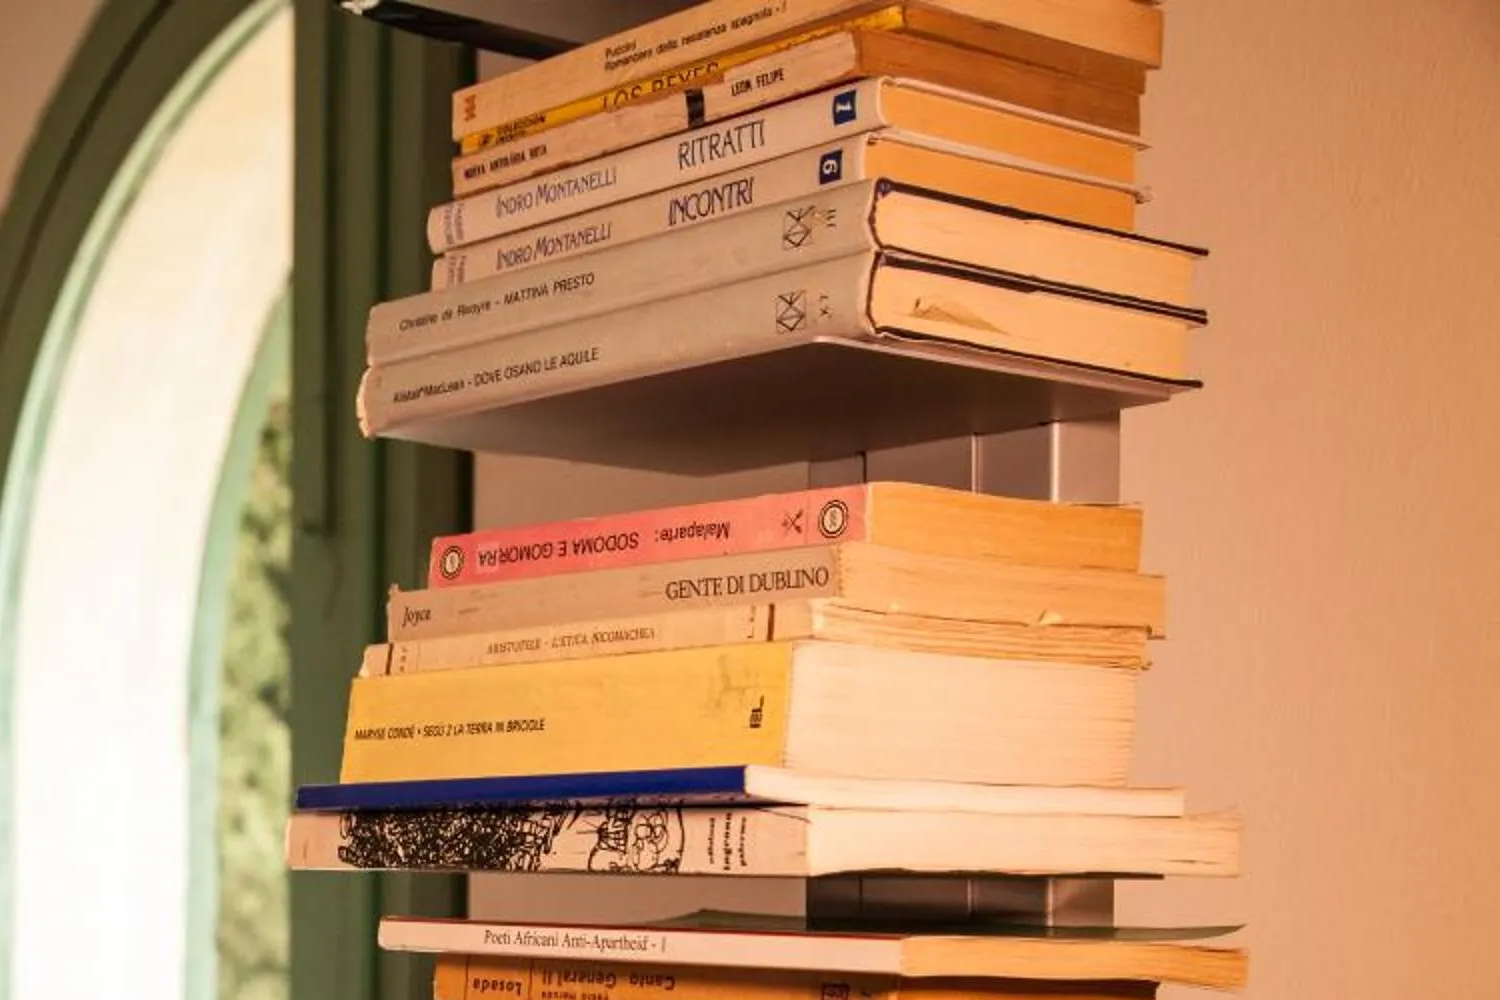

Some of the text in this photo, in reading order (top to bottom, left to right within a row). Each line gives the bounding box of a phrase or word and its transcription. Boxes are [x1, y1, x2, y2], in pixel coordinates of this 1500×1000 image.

[756, 67, 785, 89] FELIPE
[678, 119, 765, 170] RITRATTI
[495, 167, 617, 218] INDRO MONTANELLI
[667, 176, 755, 227] INCONTRI
[496, 245, 533, 271] INDRO
[533, 221, 613, 261] MONTANELLI
[503, 286, 550, 306] MATTINA
[553, 271, 596, 296] PRESTO
[473, 370, 502, 389] DOVE
[543, 356, 559, 372] LE
[559, 347, 600, 369] AQUILE
[478, 532, 640, 567] SODOMA E GOMORRA
[665, 566, 830, 601] GENTE DI DUBLINO
[401, 607, 432, 628] Joyce
[483, 929, 511, 945] Poeti
[515, 930, 558, 948] Africani
[561, 932, 649, 953] Anti-Apartheid
